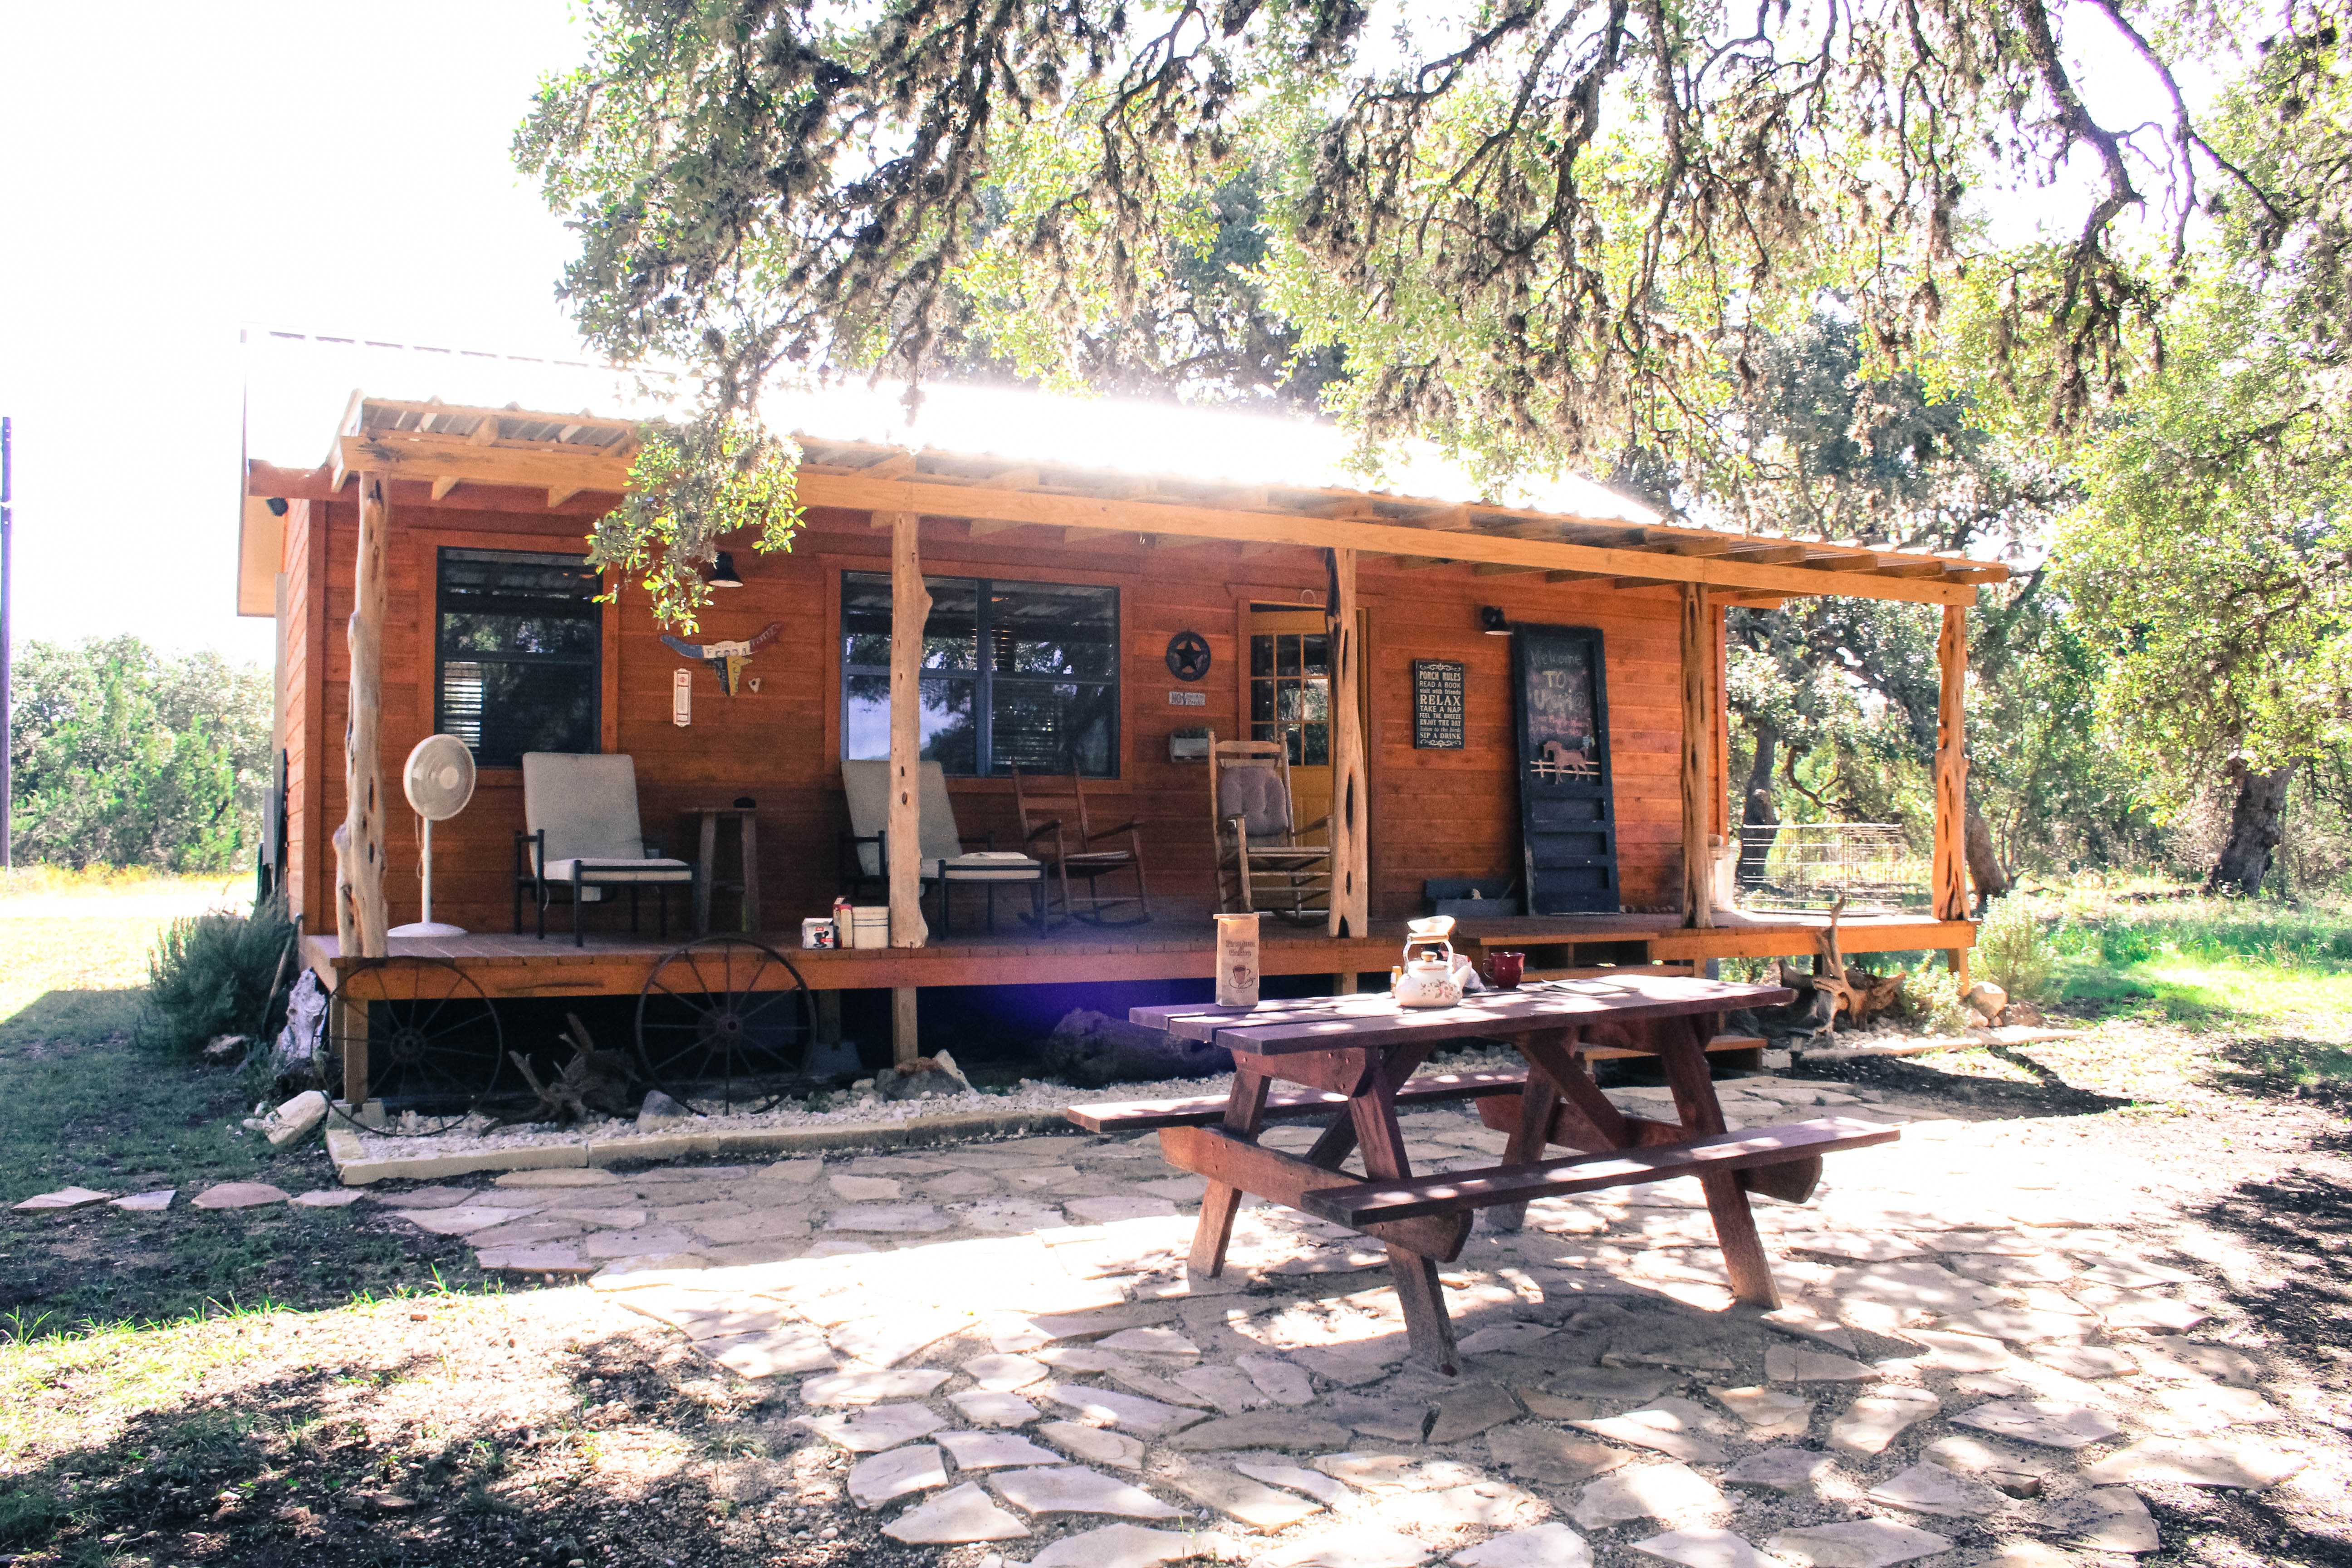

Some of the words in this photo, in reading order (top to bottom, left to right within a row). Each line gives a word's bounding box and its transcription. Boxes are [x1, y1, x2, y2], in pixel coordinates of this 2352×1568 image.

[1420, 671, 1439, 680] PORCH
[1442, 672, 1461, 681] RULES
[1543, 671, 1566, 688] TO
[1420, 695, 1461, 706] RELAX
